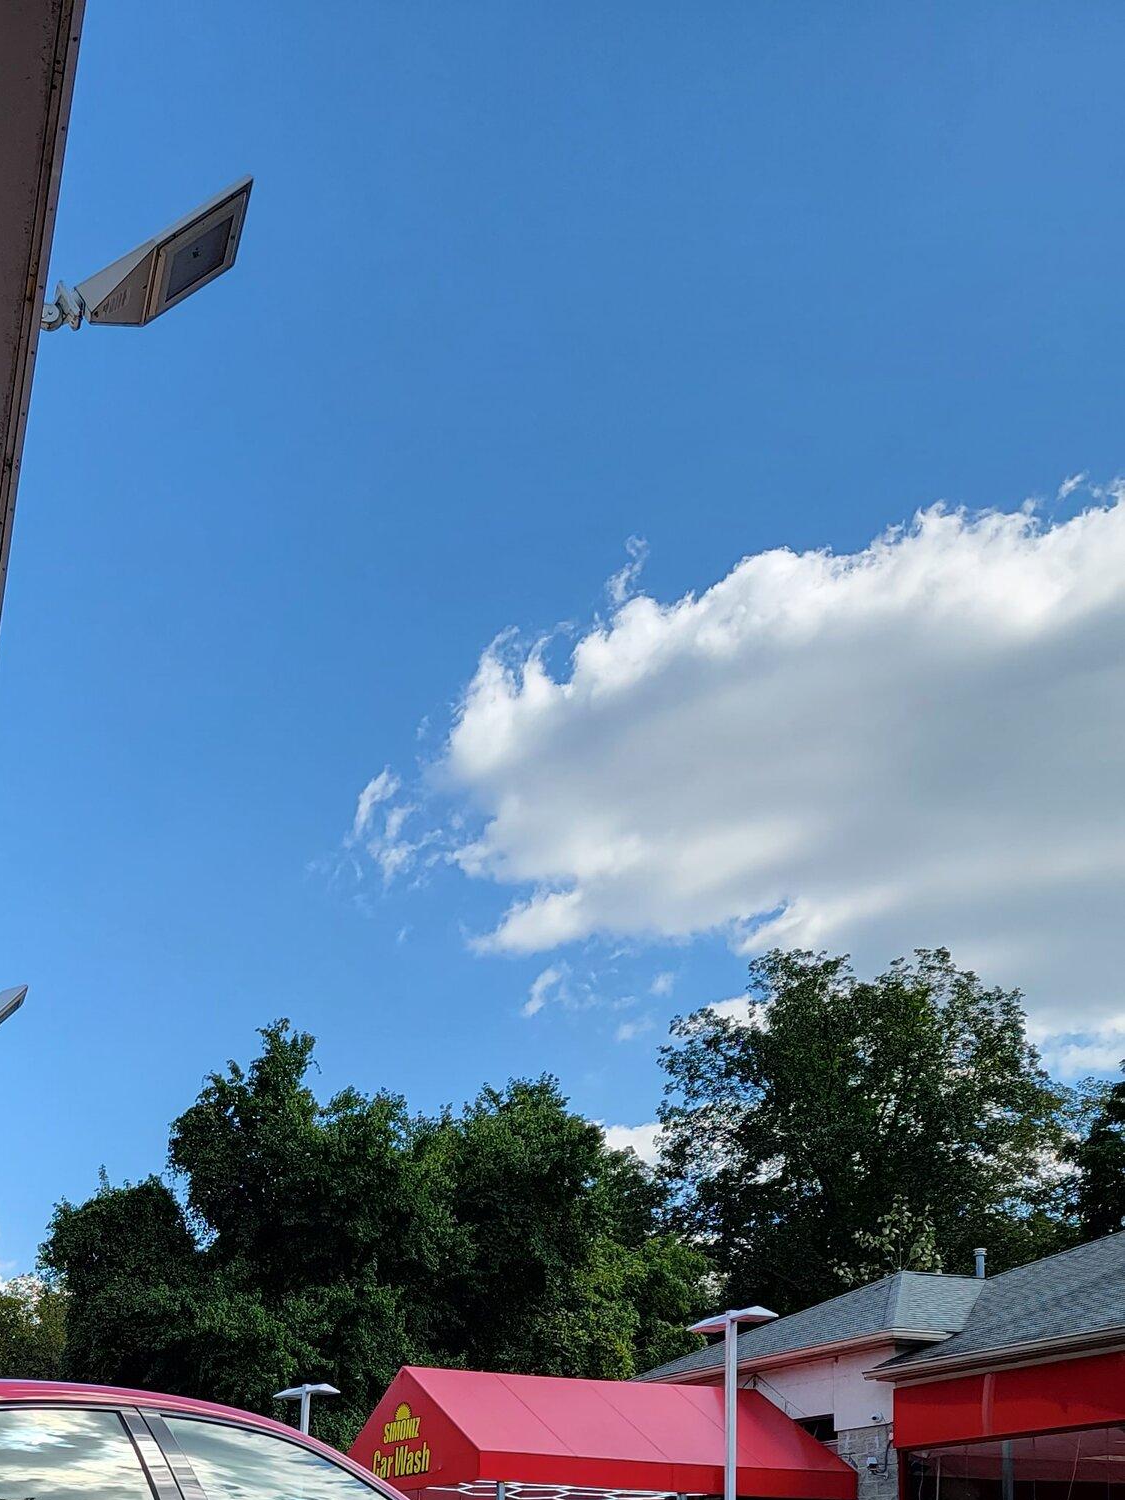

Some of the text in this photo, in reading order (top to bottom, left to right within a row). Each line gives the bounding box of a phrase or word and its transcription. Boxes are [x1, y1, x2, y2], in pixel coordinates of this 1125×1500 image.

[383, 1417, 421, 1444] SIMONIZ
[372, 1442, 431, 1479] Car Wash
